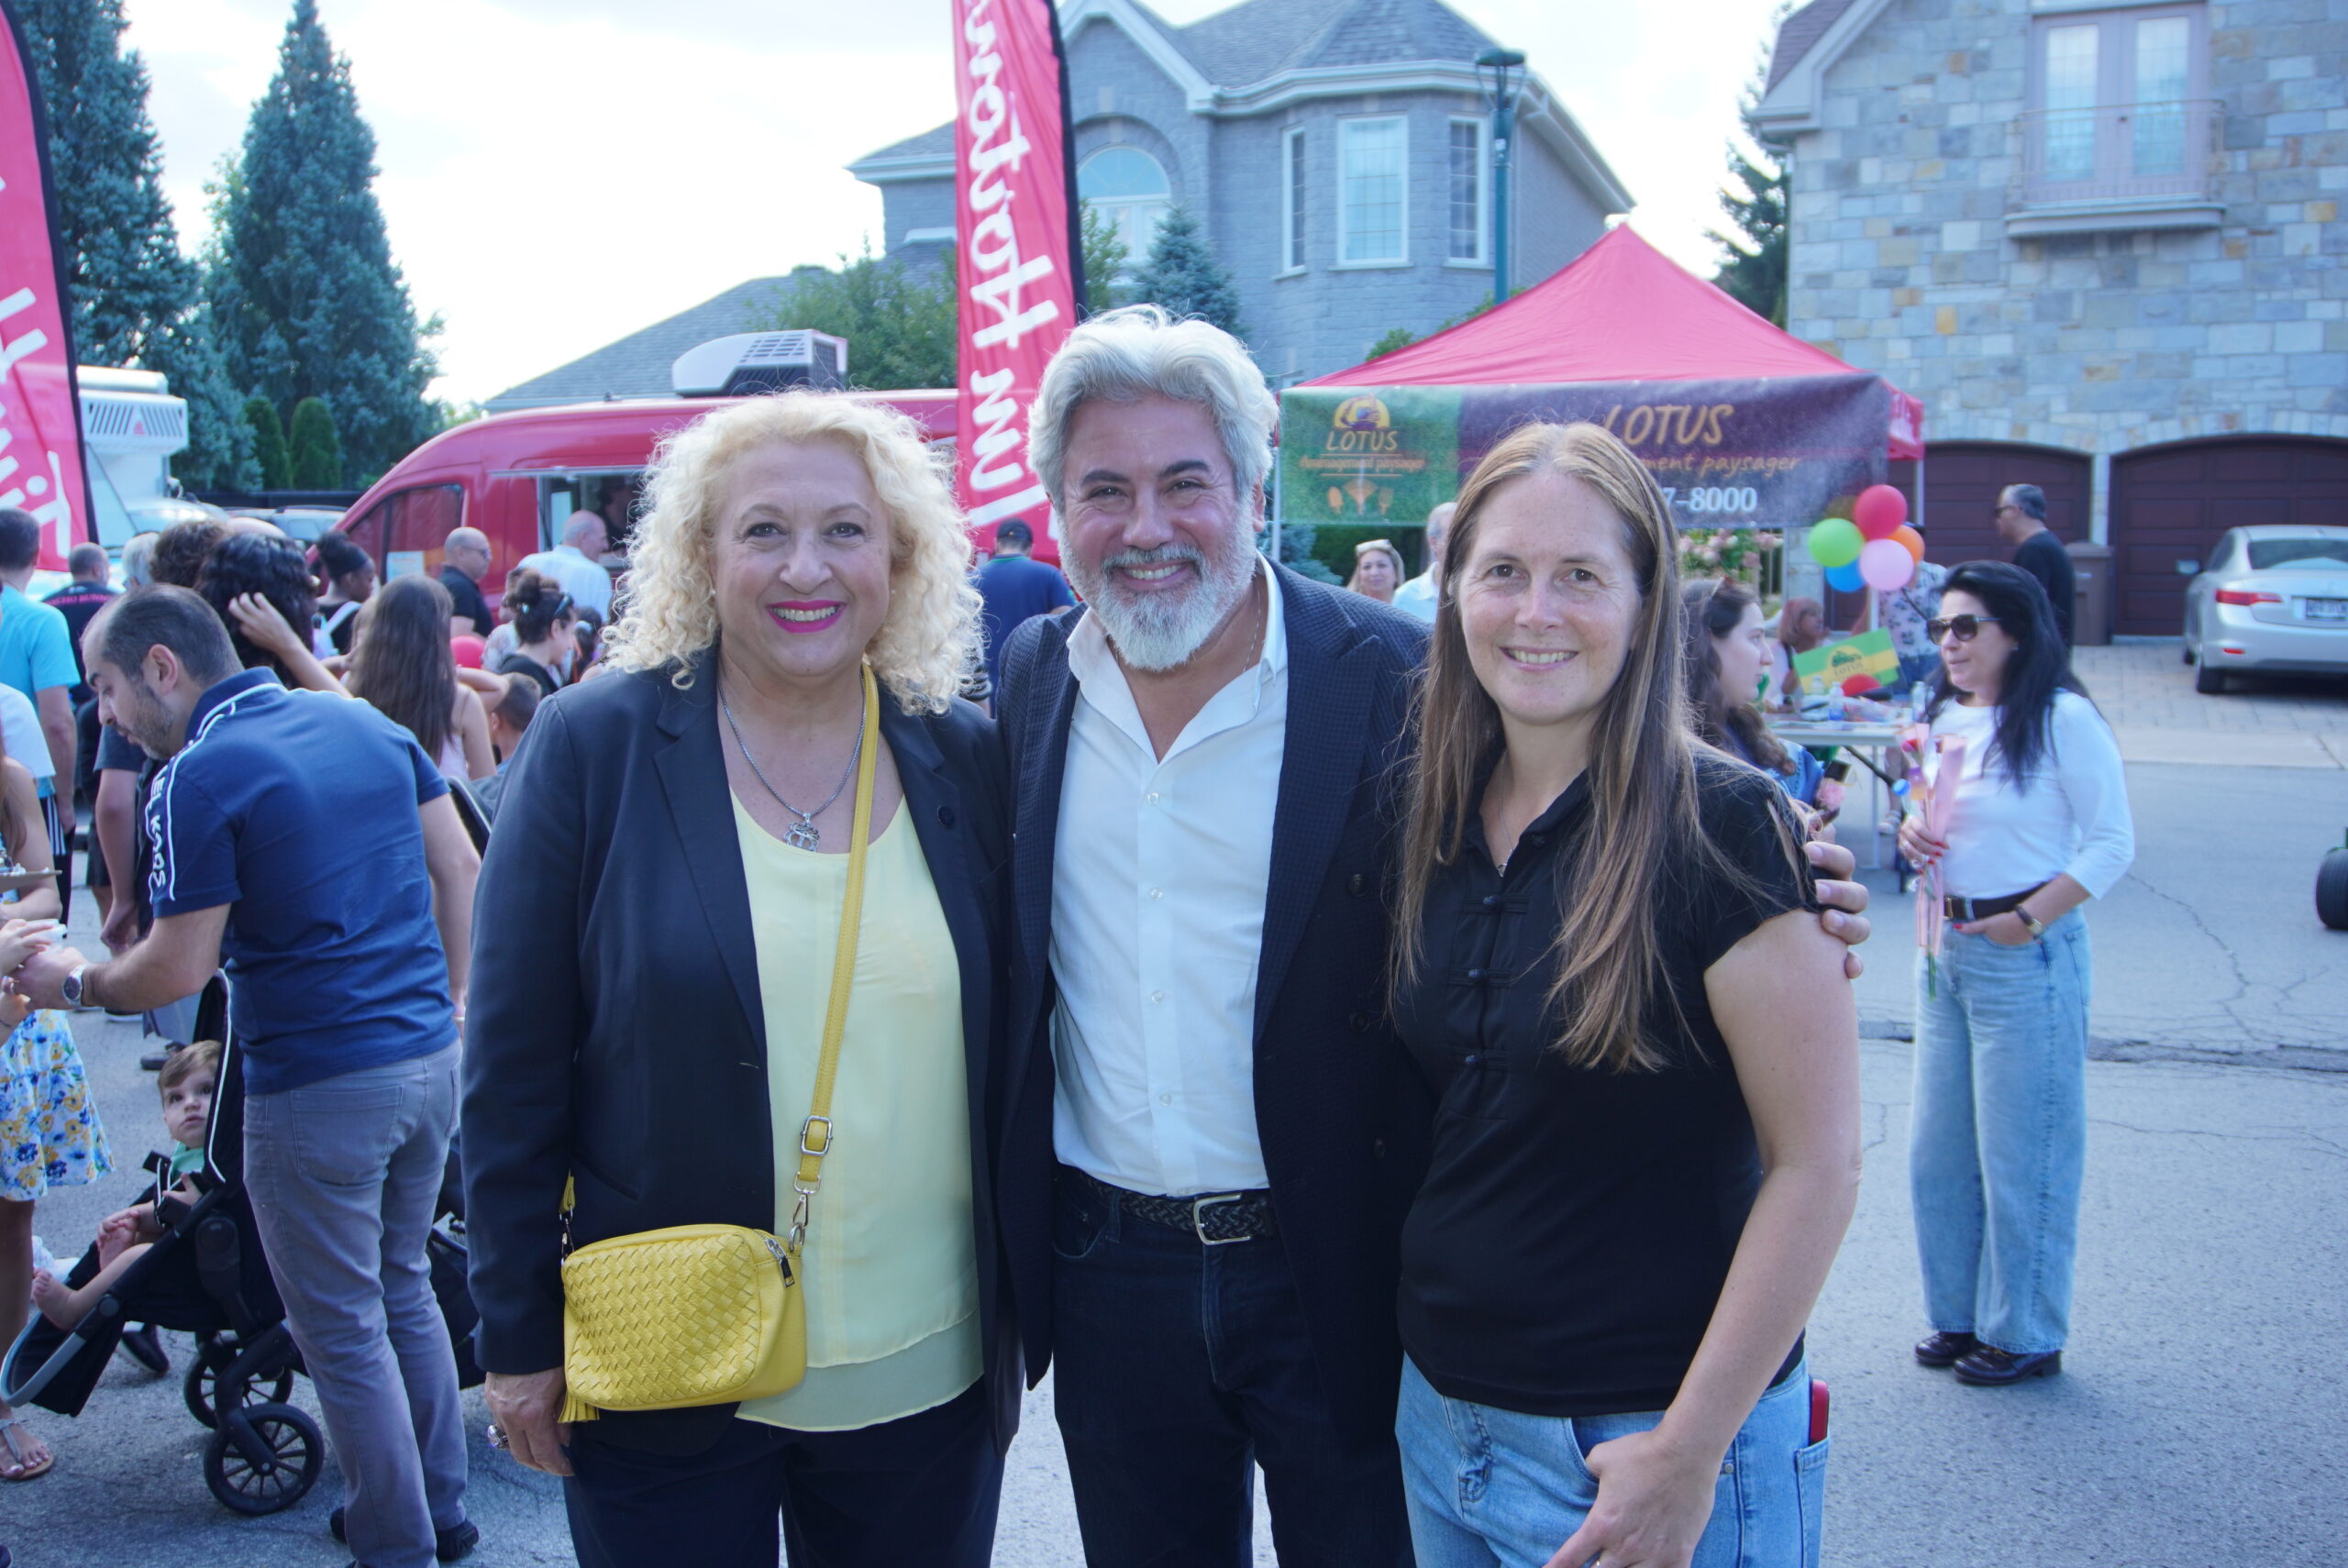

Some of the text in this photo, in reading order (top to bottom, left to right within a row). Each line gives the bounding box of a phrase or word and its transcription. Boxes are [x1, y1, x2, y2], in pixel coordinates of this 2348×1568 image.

[1326, 430, 1399, 451] LOTUS
[1699, 456, 1802, 479] paysager
[1661, 487, 1758, 513] 7-8000
